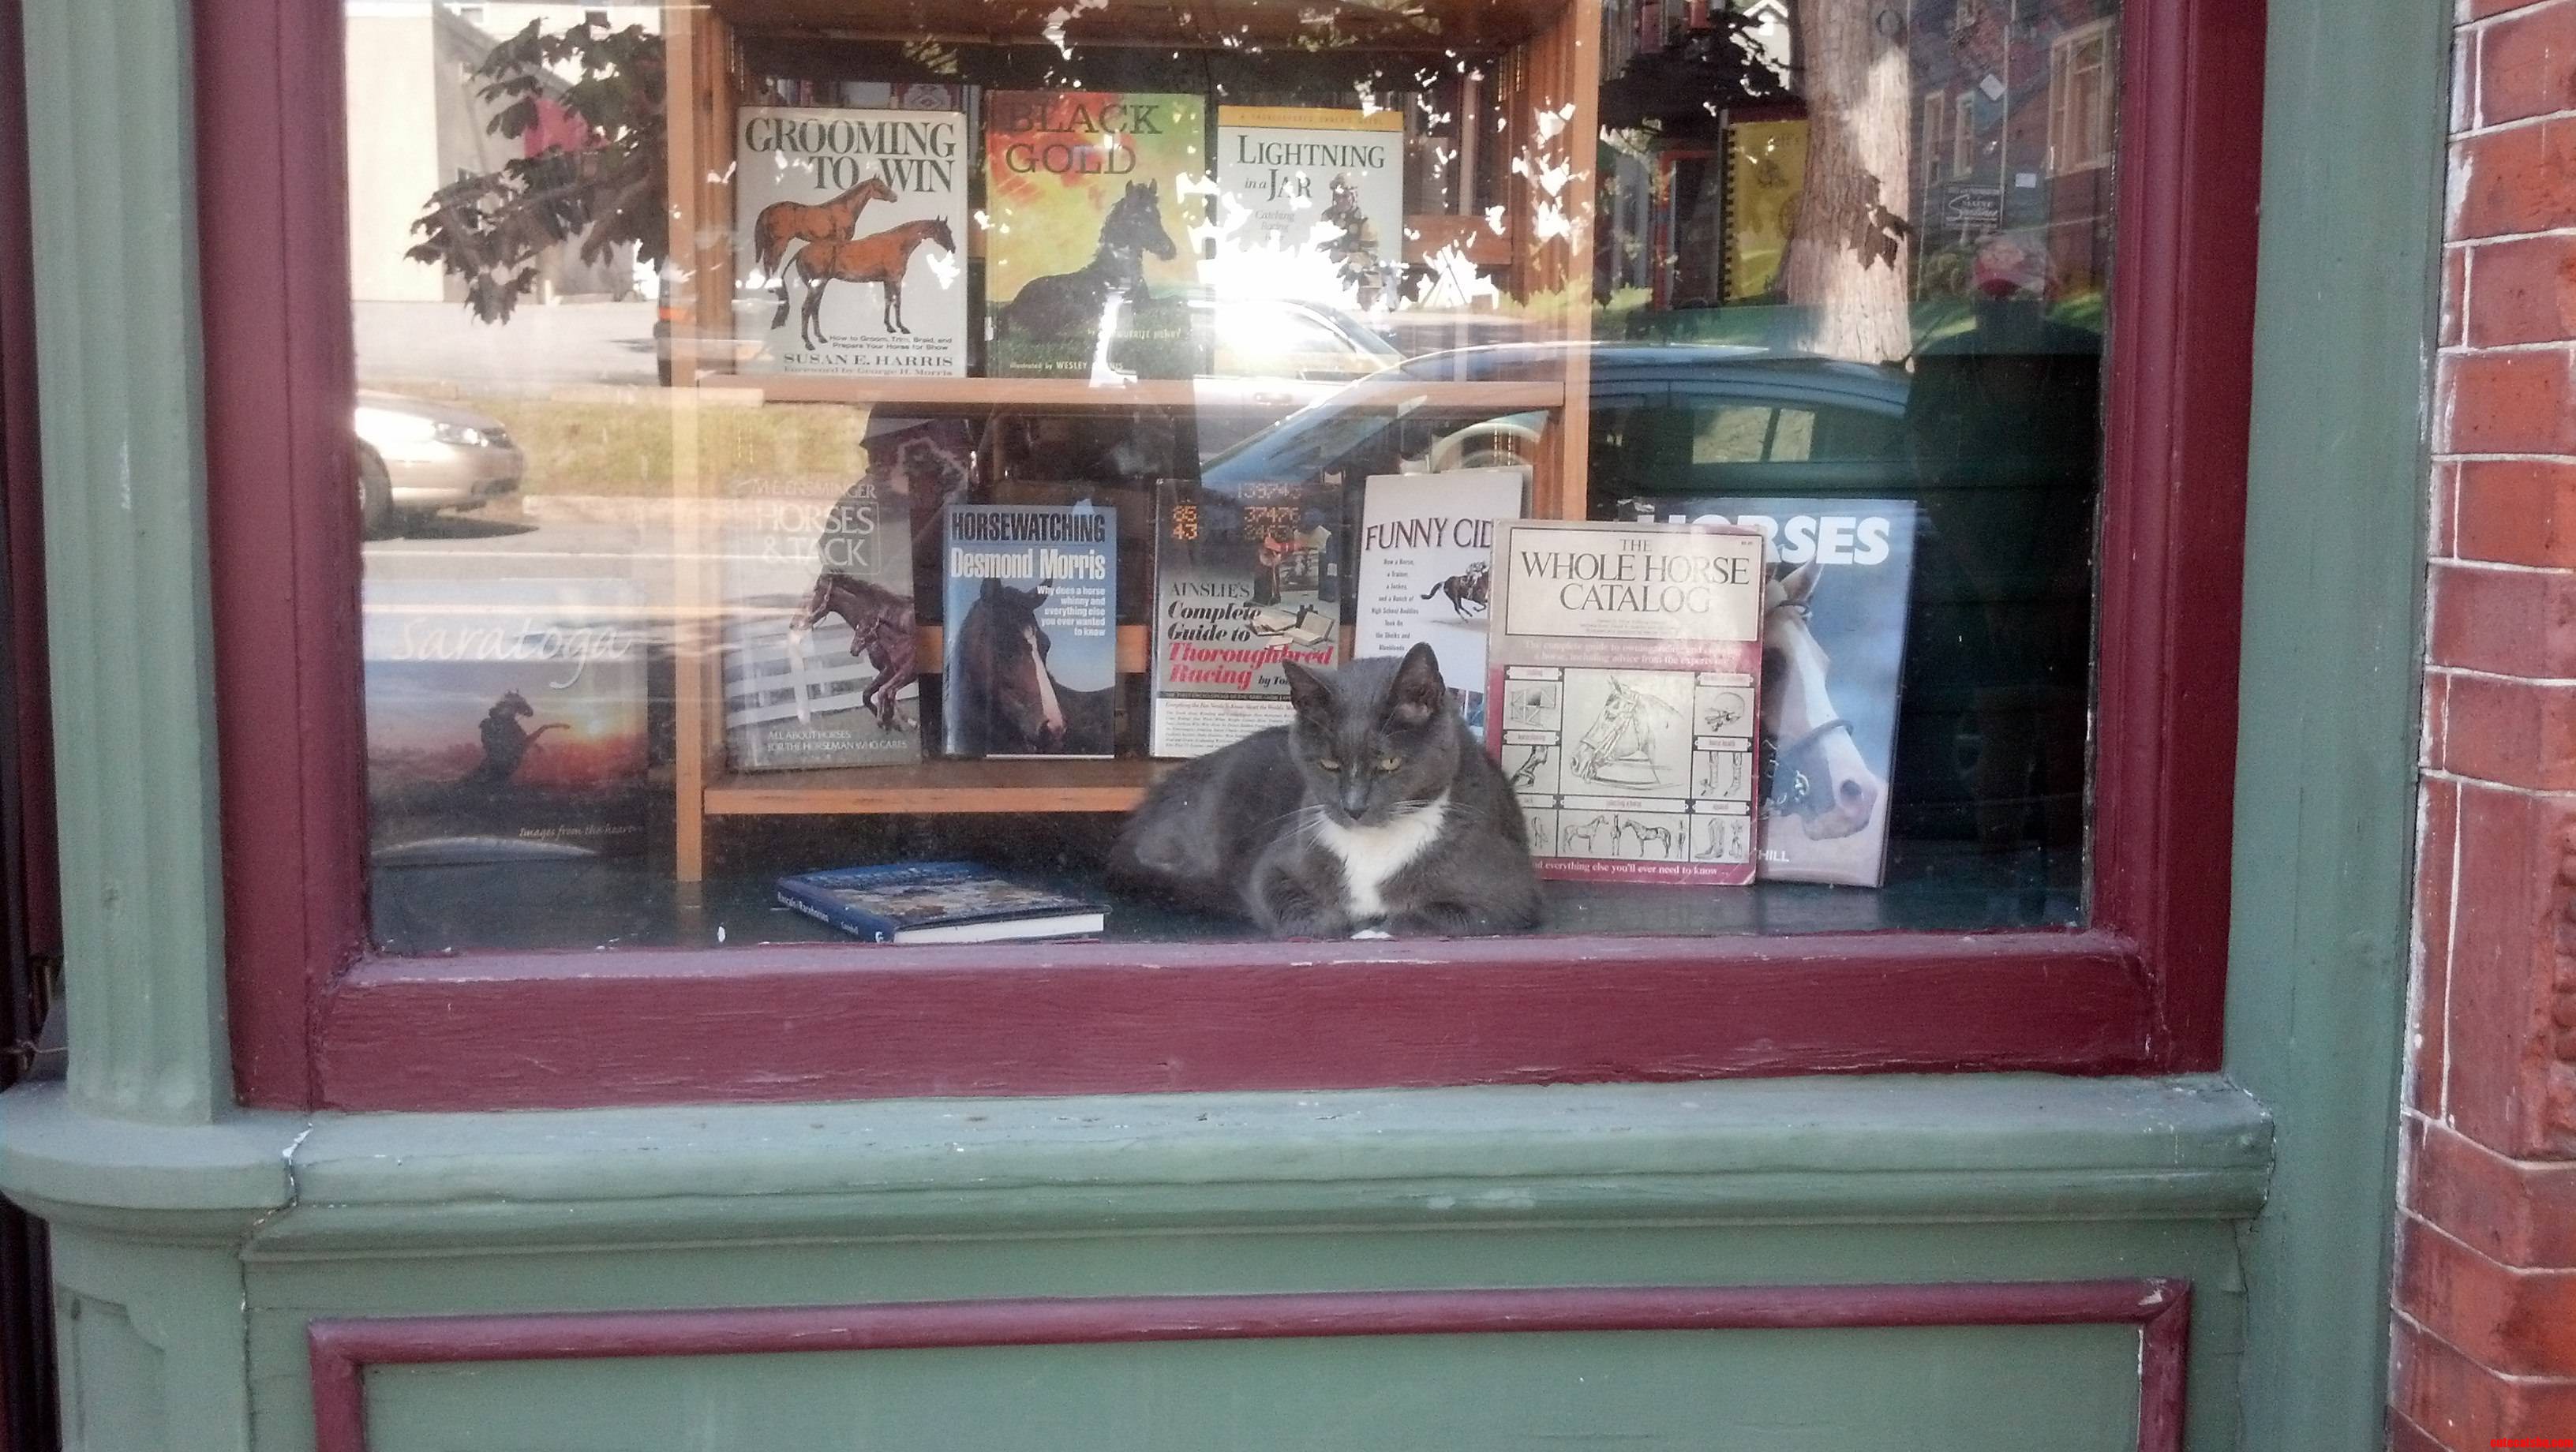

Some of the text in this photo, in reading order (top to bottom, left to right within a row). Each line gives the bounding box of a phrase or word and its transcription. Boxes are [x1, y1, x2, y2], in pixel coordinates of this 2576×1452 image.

[1009, 103, 1163, 134] BLACK
[746, 118, 957, 158] GROOMING
[1005, 143, 1136, 174] GOLD
[1237, 134, 1386, 168] LIGHTNING
[809, 156, 953, 193] TO WIN
[1245, 178, 1257, 189] in
[1267, 169, 1312, 201] JAR
[1256, 210, 1295, 223] Catching
[784, 354, 953, 366] SUSAN E. HARRIS
[758, 503, 874, 535] HORSES
[951, 513, 1106, 543] HORSEWATCHING
[1365, 518, 1492, 551] FUNNY CID
[1619, 539, 1653, 552] THE
[762, 537, 869, 567] & TACK
[951, 547, 1106, 580] Desmond Morris
[1522, 551, 1750, 585] WHOLE HORSE
[1037, 586, 1054, 596] Why
[1083, 586, 1106, 595] horse
[1171, 582, 1250, 598] AINSLIE'S
[1559, 582, 1711, 613] CATALOG
[1044, 607, 1087, 616] everything
[1061, 597, 1089, 606] whinny
[1167, 601, 1262, 623] Complete
[1041, 618, 1056, 627] you
[1074, 627, 1082, 636] to
[1167, 622, 1252, 642] Guide to
[395, 616, 635, 688] Saratoga
[1169, 642, 1335, 669] Thoroughbred
[1612, 653, 1639, 663] advice
[1642, 655, 1662, 664] from
[1664, 655, 1679, 664] the
[1169, 664, 1253, 690] Racing
[1258, 676, 1271, 687] by
[769, 731, 784, 739] ALL
[786, 731, 814, 739] ABOUT
[879, 740, 908, 750] CARES
[519, 828, 556, 840] Images
[556, 824, 582, 841] from
[585, 825, 603, 835] the
[1544, 861, 1590, 873] everything
[1592, 862, 1610, 871] else
[1611, 863, 1636, 874] you'll
[1659, 865, 1679, 874] need
[1682, 866, 1692, 875] to
[1693, 866, 1717, 875] know
